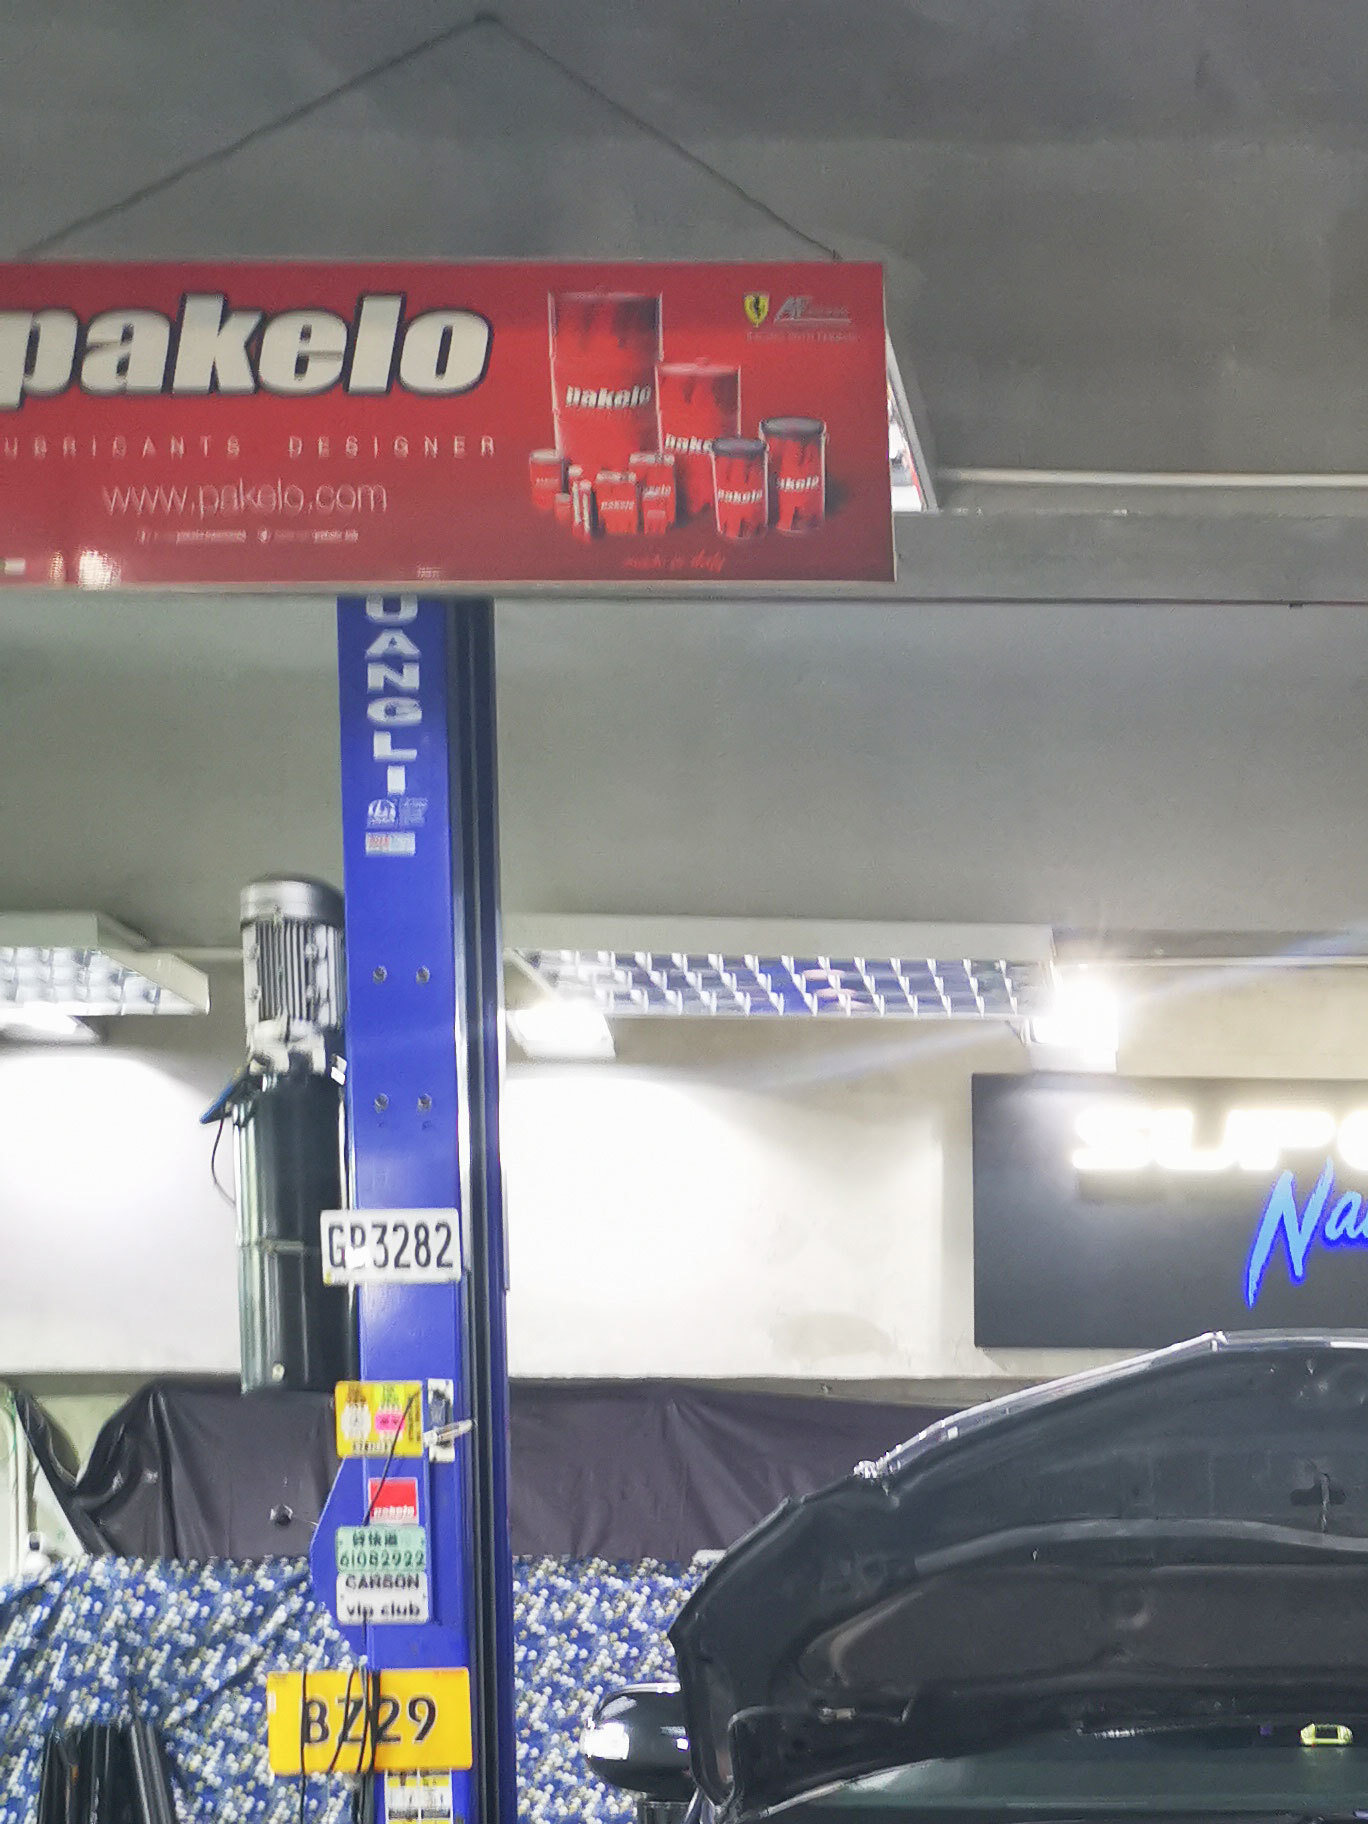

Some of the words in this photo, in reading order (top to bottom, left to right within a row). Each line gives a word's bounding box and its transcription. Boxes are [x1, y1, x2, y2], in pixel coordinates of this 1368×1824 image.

[0, 292, 494, 412] pakelo
[288, 434, 495, 459] DESIGNER
[103, 477, 388, 519] www.pakelo.com
